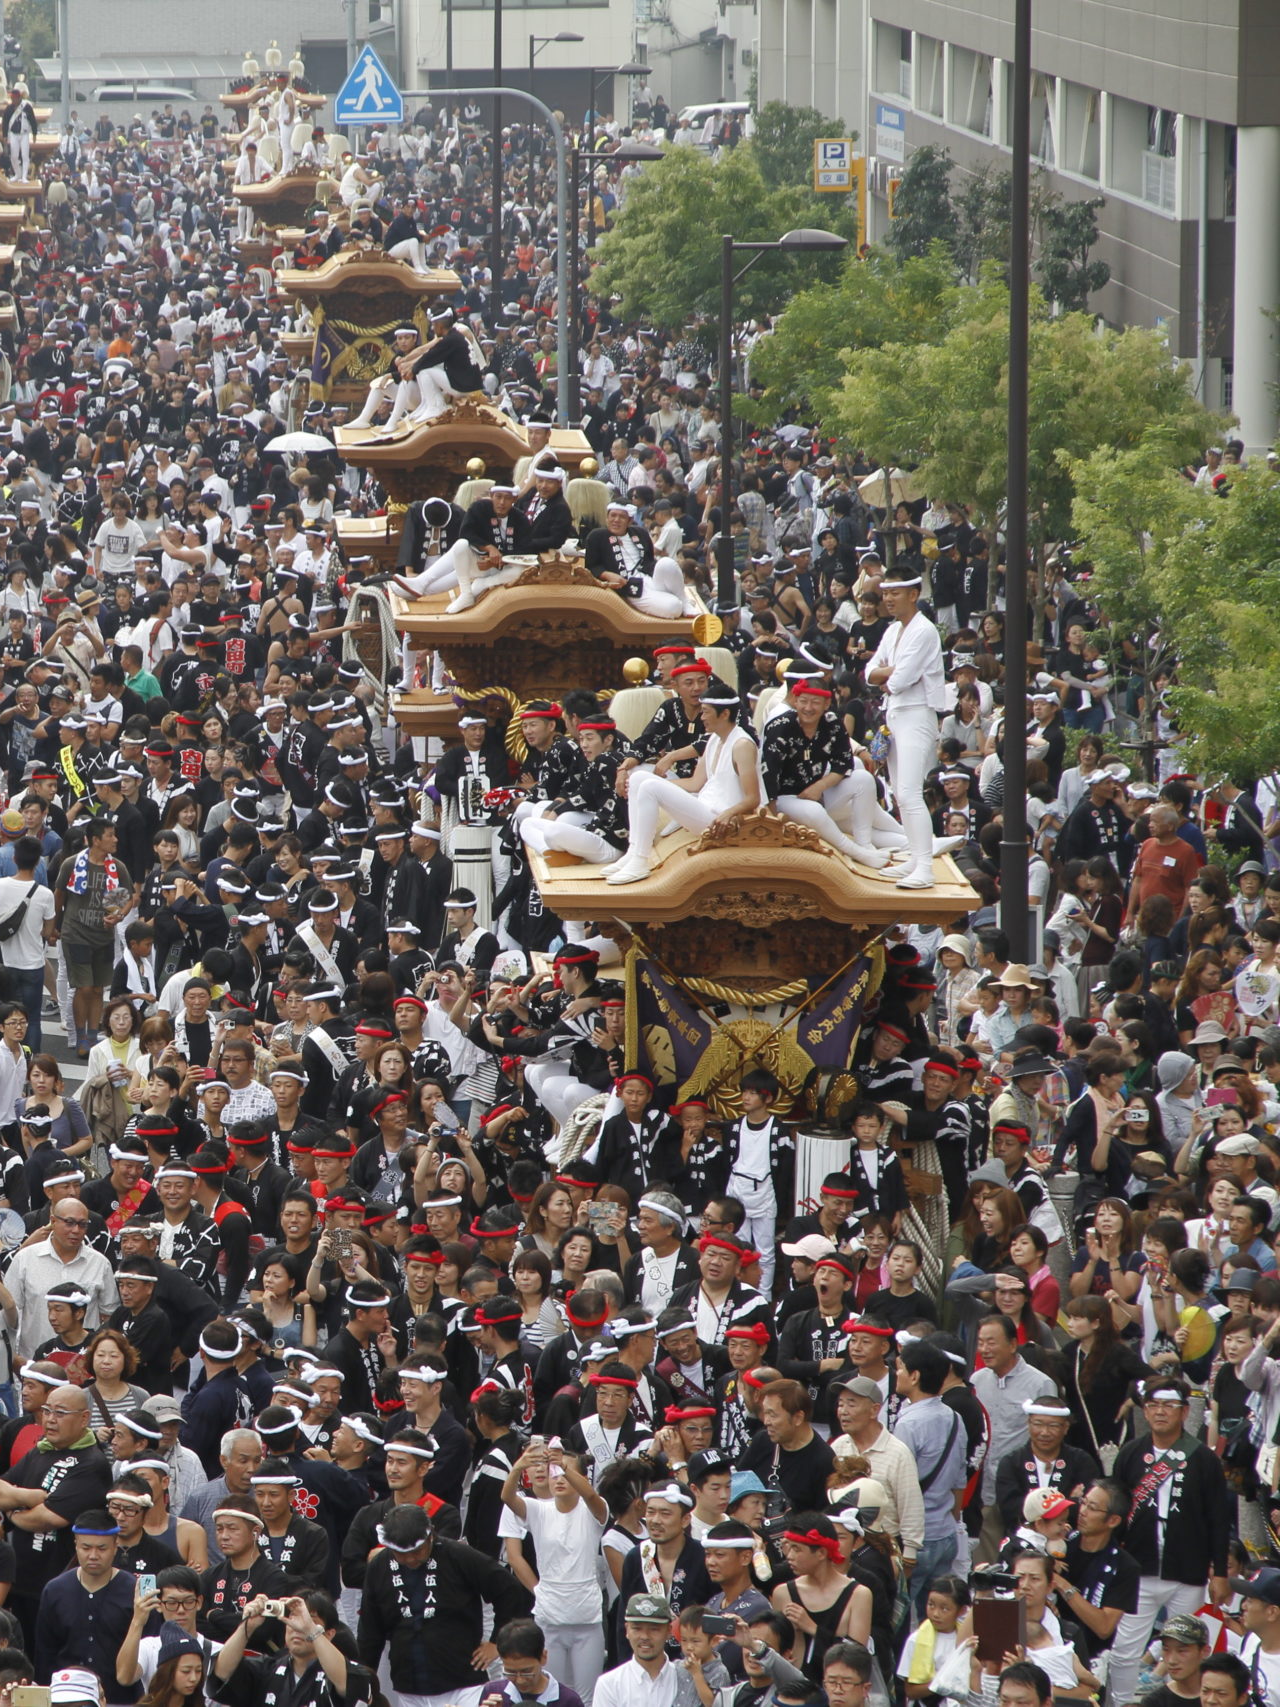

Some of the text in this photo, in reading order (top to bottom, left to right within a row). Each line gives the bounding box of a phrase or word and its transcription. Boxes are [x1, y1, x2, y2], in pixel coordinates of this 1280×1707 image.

[826, 144, 841, 158] P
[823, 160, 846, 168] 入口
[89, 893, 102, 907] AS
[703, 1449, 721, 1465] LOS
